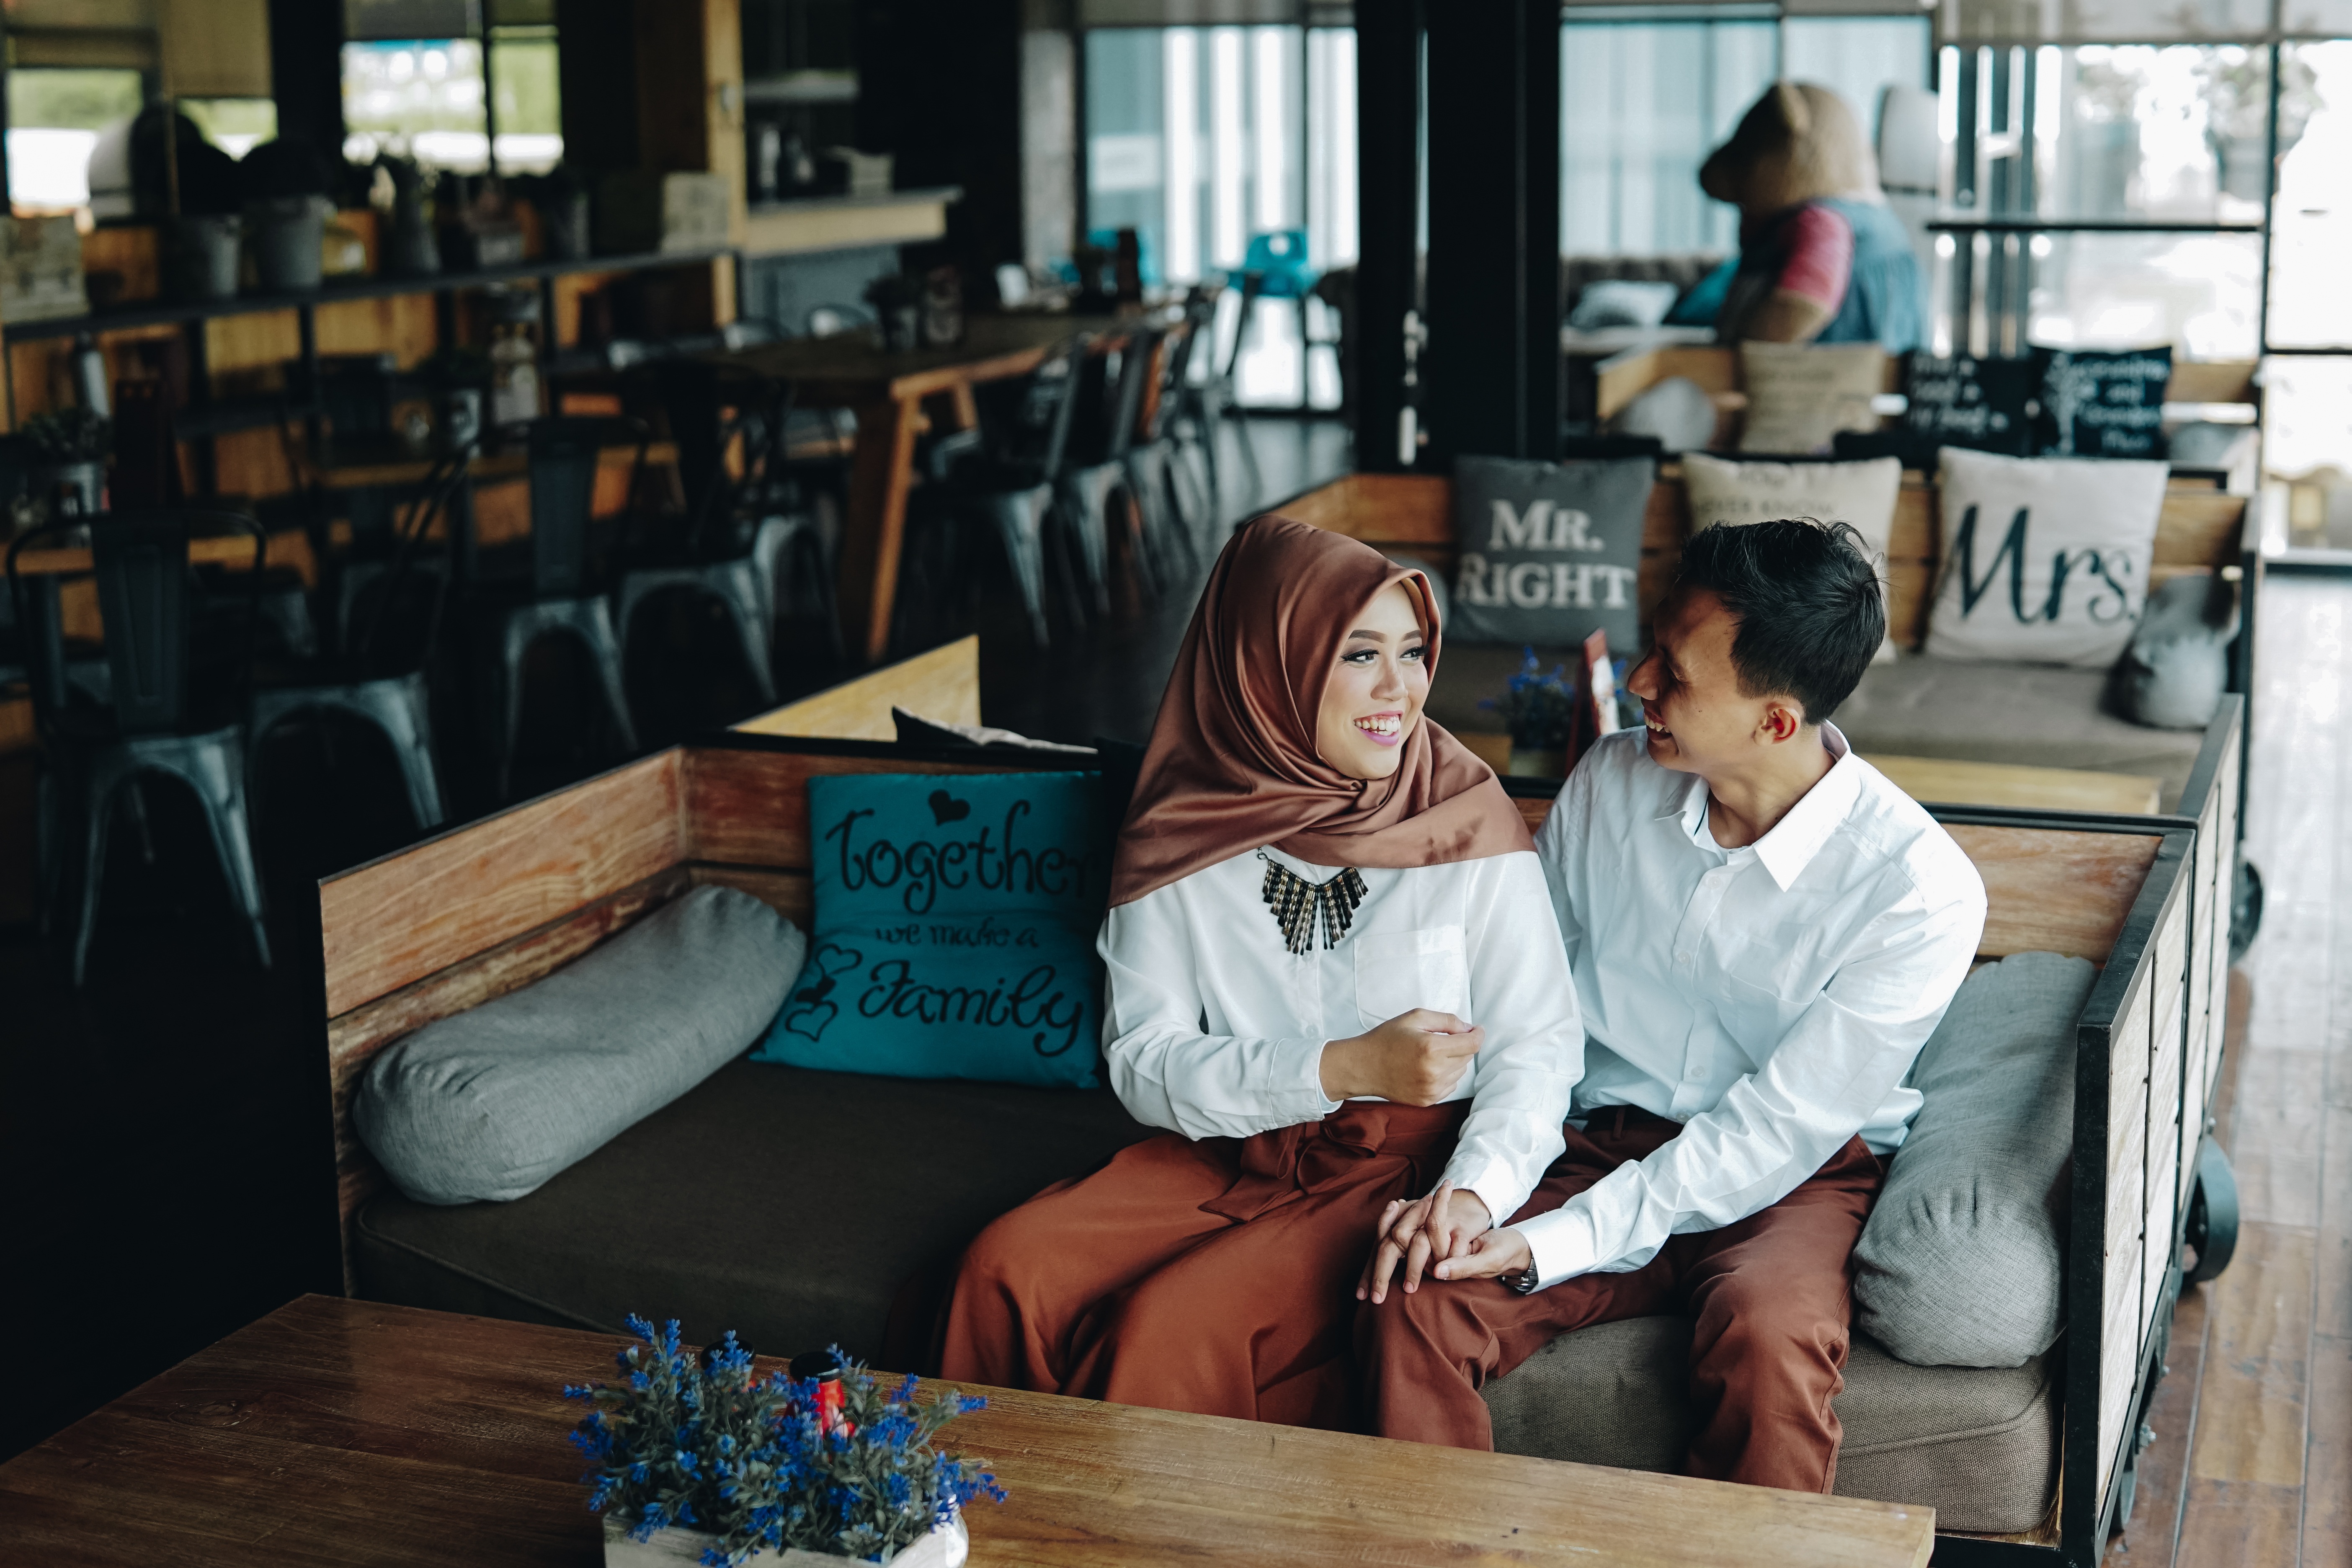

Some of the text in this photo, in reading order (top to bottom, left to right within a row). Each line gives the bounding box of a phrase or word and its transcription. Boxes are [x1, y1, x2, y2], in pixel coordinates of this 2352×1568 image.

[1455, 552, 1638, 610] RIGHT
[825, 800, 1098, 914] Together
[874, 916, 1039, 948] we make a
[858, 959, 1084, 1057] Family
